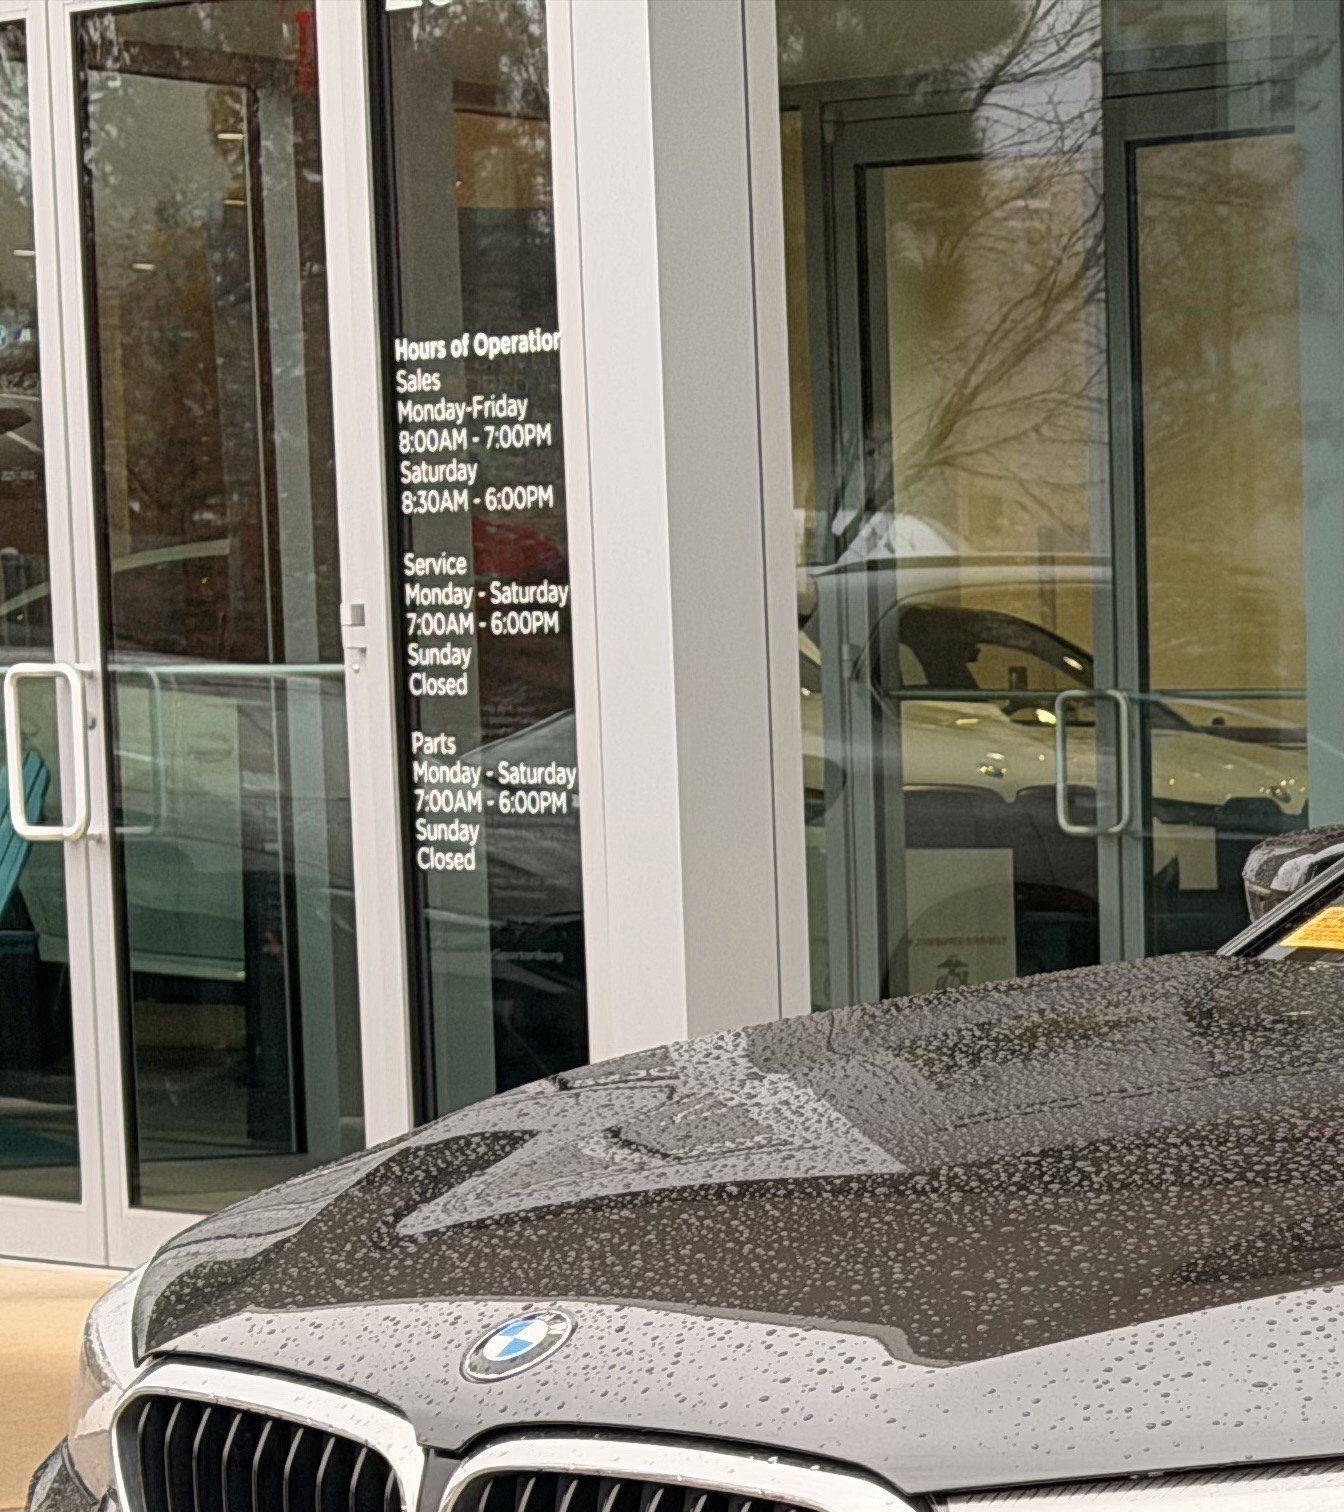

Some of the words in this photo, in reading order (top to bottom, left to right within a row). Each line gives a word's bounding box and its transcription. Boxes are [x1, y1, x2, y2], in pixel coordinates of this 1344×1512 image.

[394, 337, 447, 362] Hours
[450, 332, 471, 359] of
[395, 367, 442, 394] Sales
[397, 393, 529, 425] Monday-Friday
[398, 427, 468, 454] 8:00AM
[483, 422, 552, 450] 7:00PM
[400, 457, 479, 486] Saturday
[400, 487, 469, 515] 8:30AM
[484, 484, 554, 512] 6:00PM
[403, 551, 468, 577] Service
[404, 581, 474, 610] Monday
[489, 579, 569, 608] Saturday
[406, 611, 475, 636] 7:00AM
[490, 610, 560, 636] 6:00PM
[407, 641, 473, 670] Sunday
[409, 671, 469, 697] Closed
[411, 730, 457, 756] Parts
[412, 759, 482, 789] Monday
[497, 760, 577, 790] Saturday
[414, 788, 484, 814] 7:00AM
[498, 789, 568, 815] 6:00PM
[415, 817, 481, 847] Sunday
[416, 845, 476, 871] Closed
